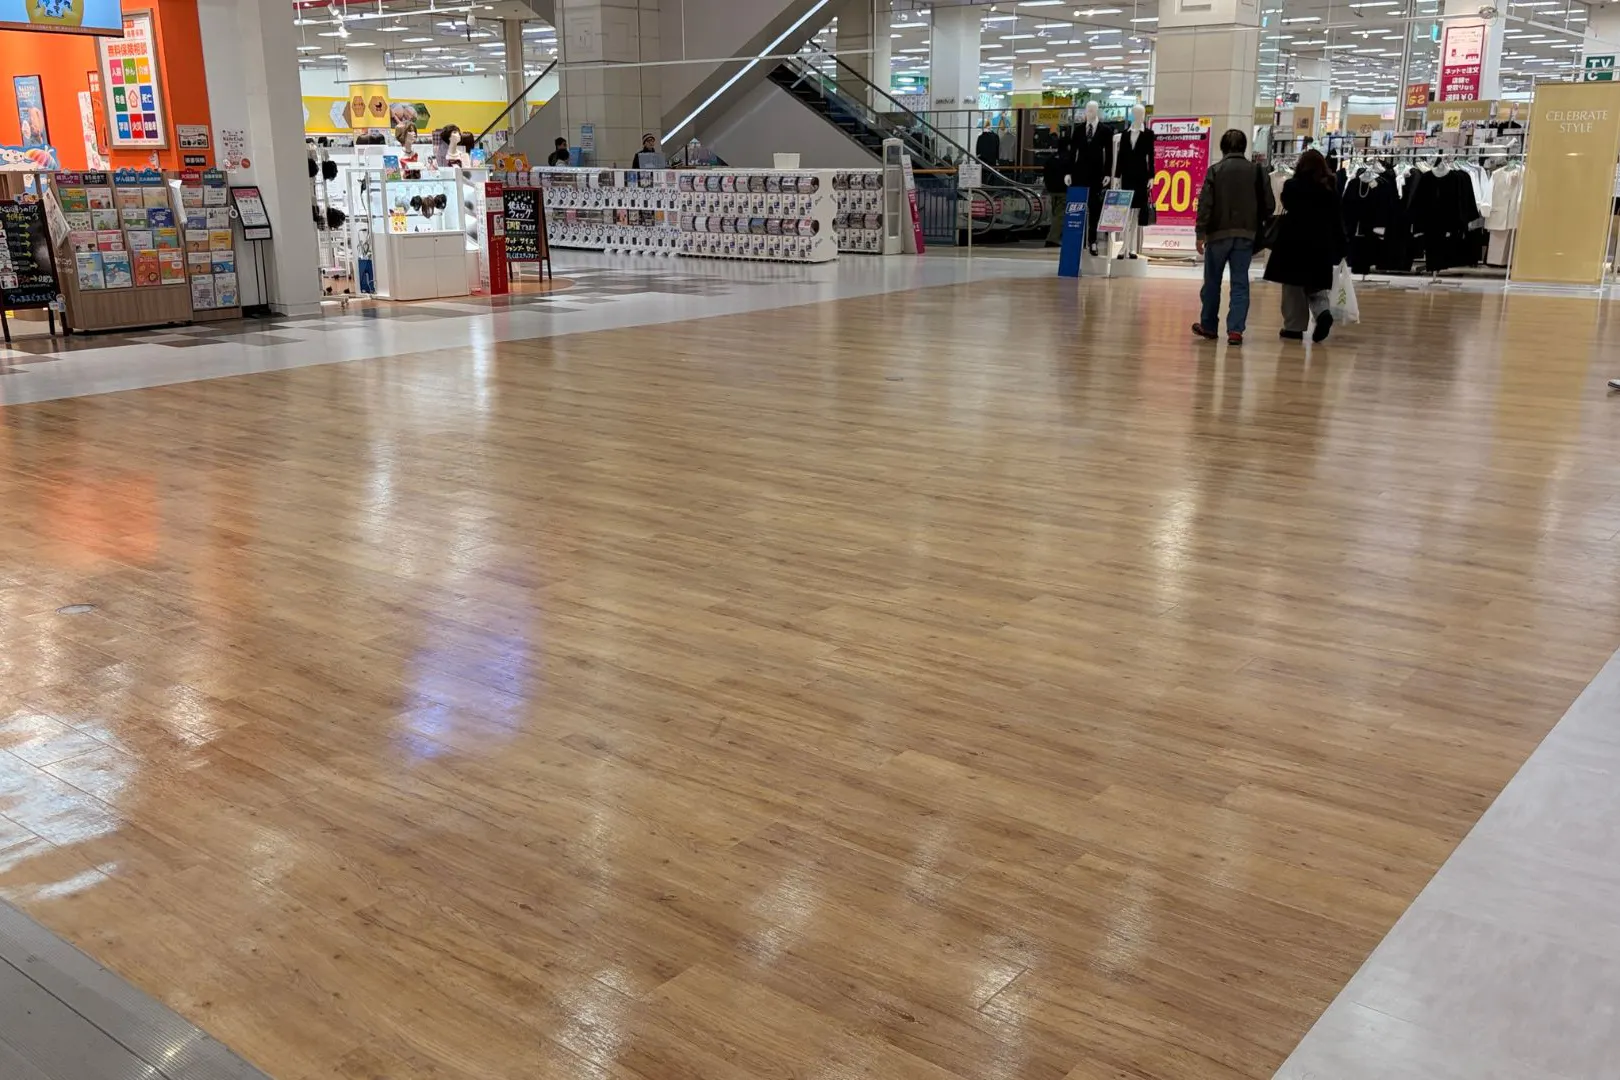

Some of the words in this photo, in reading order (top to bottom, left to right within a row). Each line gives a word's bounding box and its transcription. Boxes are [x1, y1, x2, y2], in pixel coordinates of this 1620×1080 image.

[1445, 66, 1479, 75] ネットで注文
[1545, 110, 1608, 121] CELEBRATE
[1560, 122, 1593, 133] STYLE
